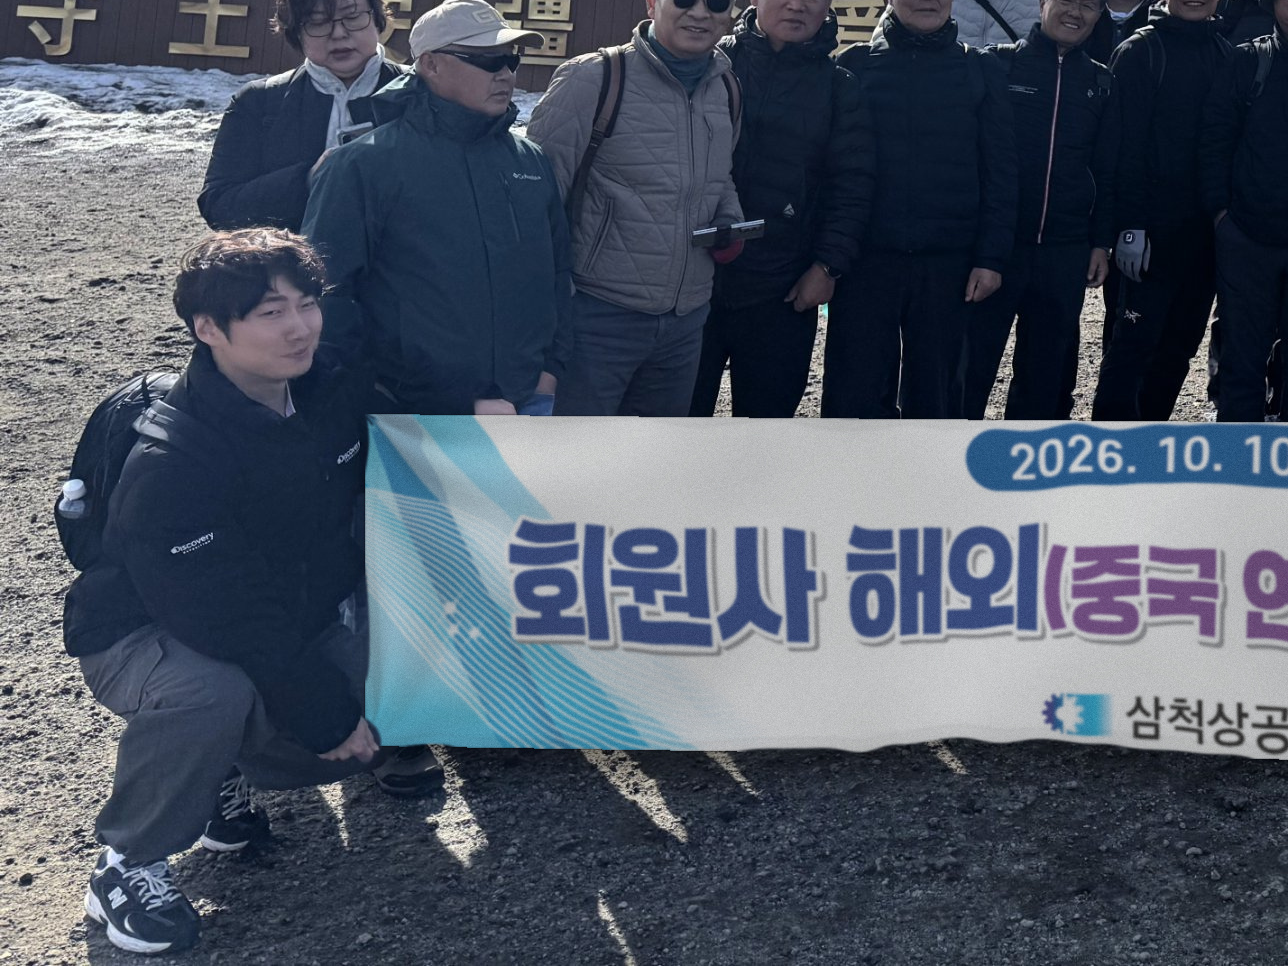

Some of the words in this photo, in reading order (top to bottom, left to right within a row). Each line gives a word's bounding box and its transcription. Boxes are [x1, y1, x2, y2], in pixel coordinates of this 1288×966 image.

[1010, 434, 1137, 481] 2026.
[1158, 435, 1223, 474] 10.
[171, 532, 214, 554] Discovery
[507, 518, 819, 649] 회원사
[845, 522, 1221, 640] 해외(중국
